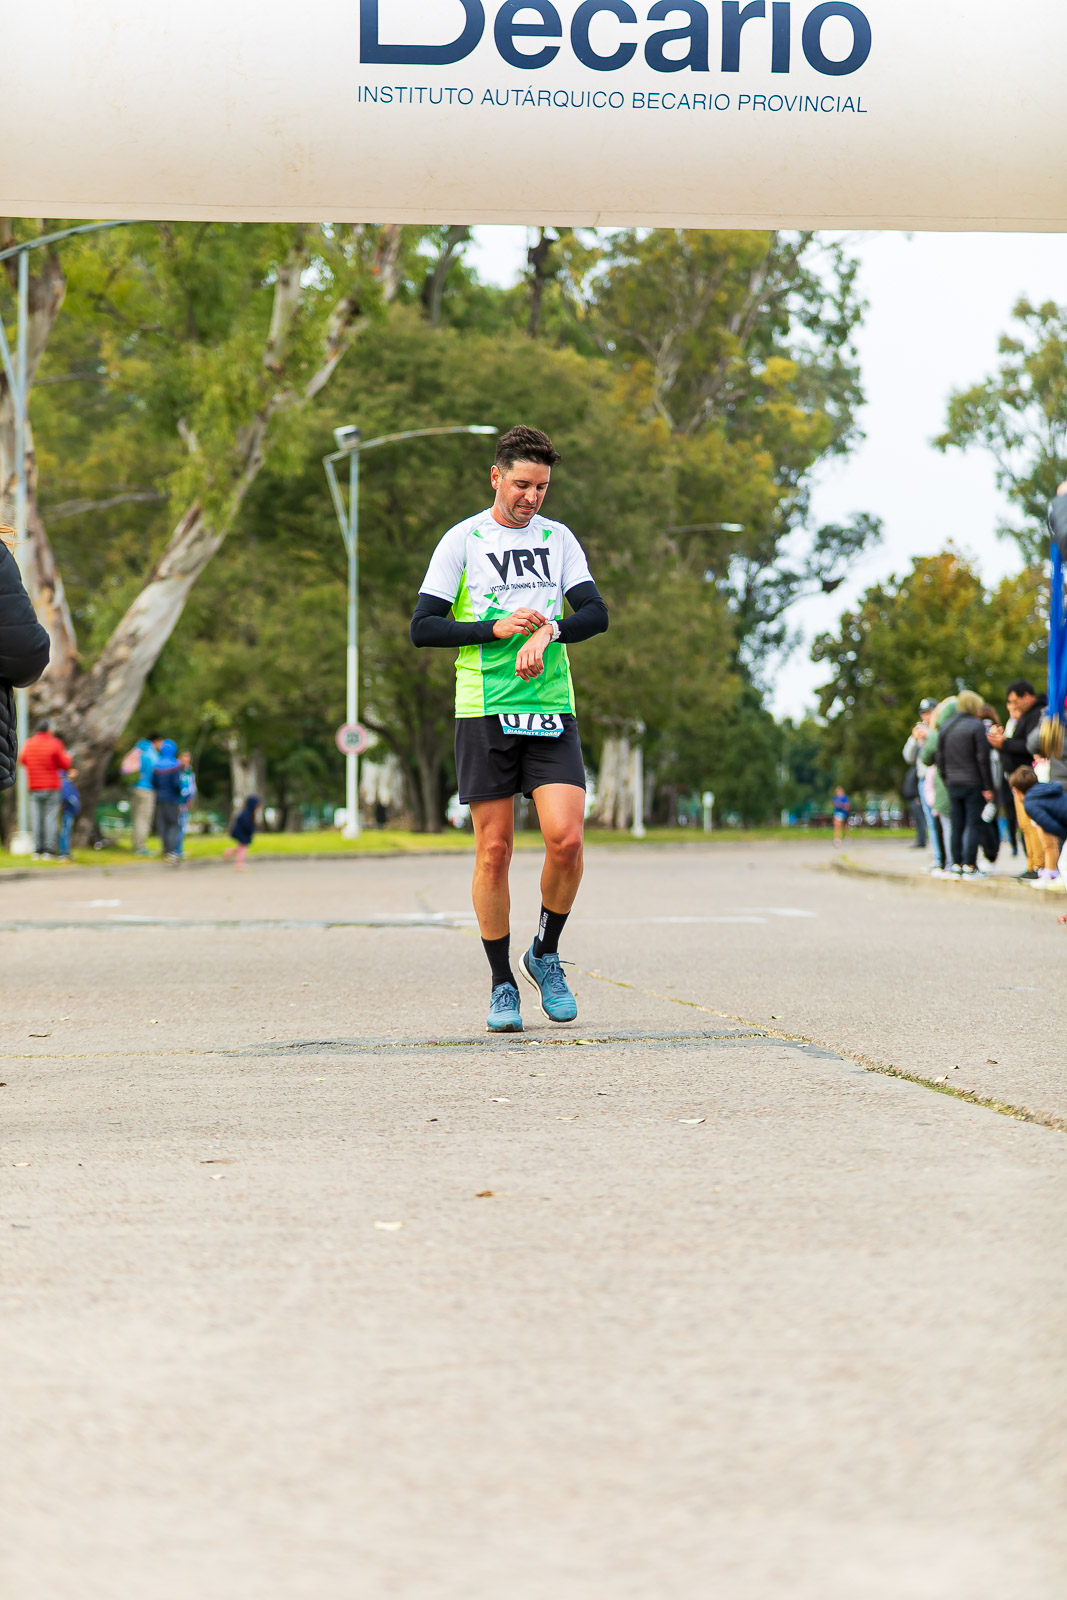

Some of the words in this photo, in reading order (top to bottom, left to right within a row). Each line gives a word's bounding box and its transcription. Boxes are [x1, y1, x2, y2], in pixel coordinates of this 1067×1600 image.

[357, 85, 474, 106] INSTITUTO
[480, 85, 625, 109] AUTÁRQUICO
[632, 92, 731, 111] BECARIO
[738, 94, 868, 113] PROVINCIAL
[485, 547, 551, 585] VRT
[511, 582, 532, 590] RUNNING
[507, 728, 539, 736] DIAMANTE
